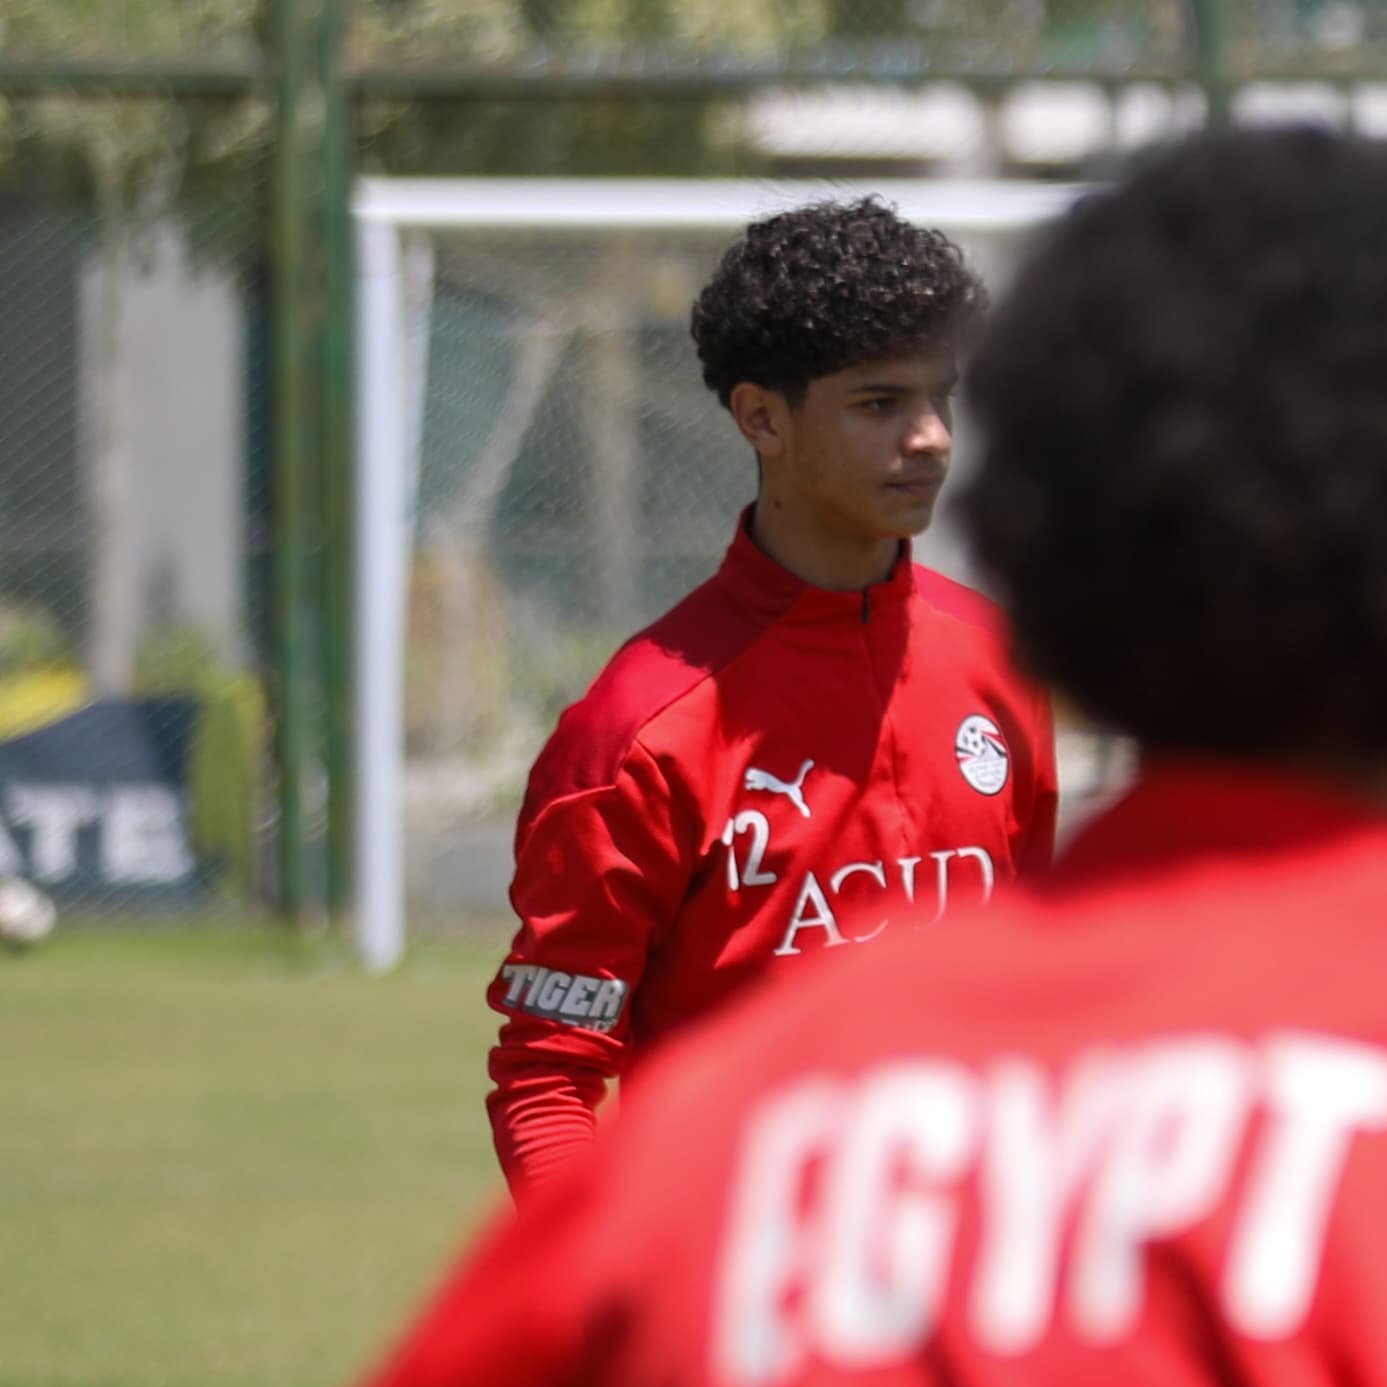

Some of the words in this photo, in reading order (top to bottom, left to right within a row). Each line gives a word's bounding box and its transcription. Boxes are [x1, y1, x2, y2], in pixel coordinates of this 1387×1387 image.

[0, 783, 195, 885] TE
[721, 810, 777, 891] 12
[503, 964, 626, 1018] TIGER
